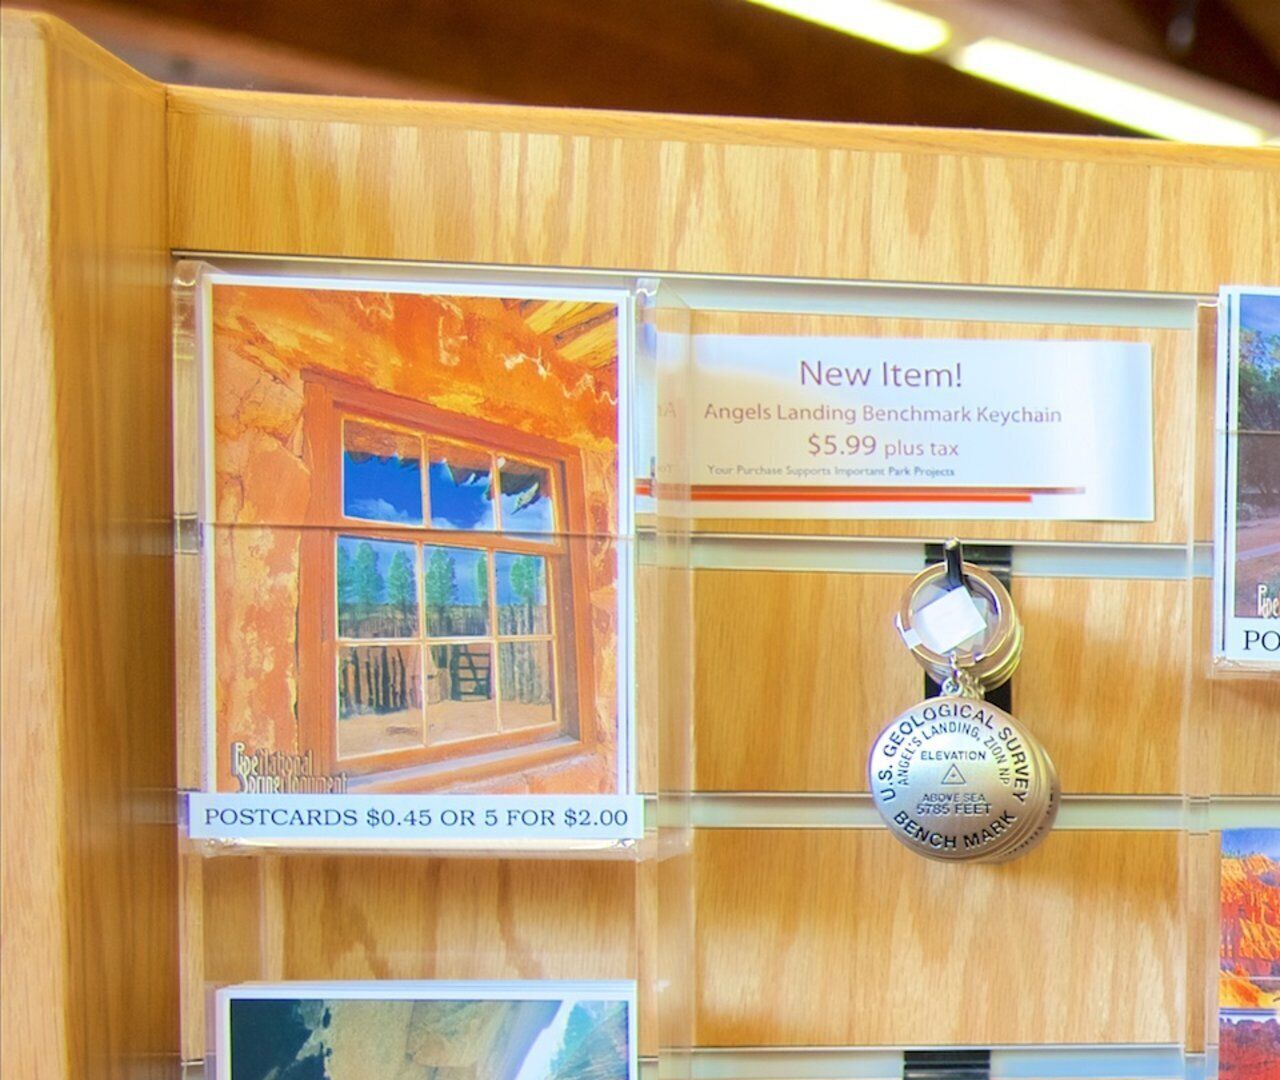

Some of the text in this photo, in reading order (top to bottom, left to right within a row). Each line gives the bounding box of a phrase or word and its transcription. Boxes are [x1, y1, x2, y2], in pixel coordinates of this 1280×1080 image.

[800, 360, 962, 388] New Item!
[704, 403, 1062, 427] Angels Landing Benchmark Keychain
[808, 434, 959, 460] $5.99 plus tax
[708, 465, 956, 478] Your Purchase Supports Important Park Projects
[878, 703, 1029, 806] U.S. GEOLOGICAL SURVEY
[920, 750, 987, 760] ELEVATION
[984, 735, 1007, 765] ZION
[999, 768, 1010, 785] NP
[922, 793, 986, 802] ABOVE SEA
[955, 803, 991, 815] FEET
[204, 806, 628, 828] POSTCARDS $0.45 OR 5 FOR $2.00
[893, 810, 957, 848] BENCH
[964, 811, 1016, 848] MARK
